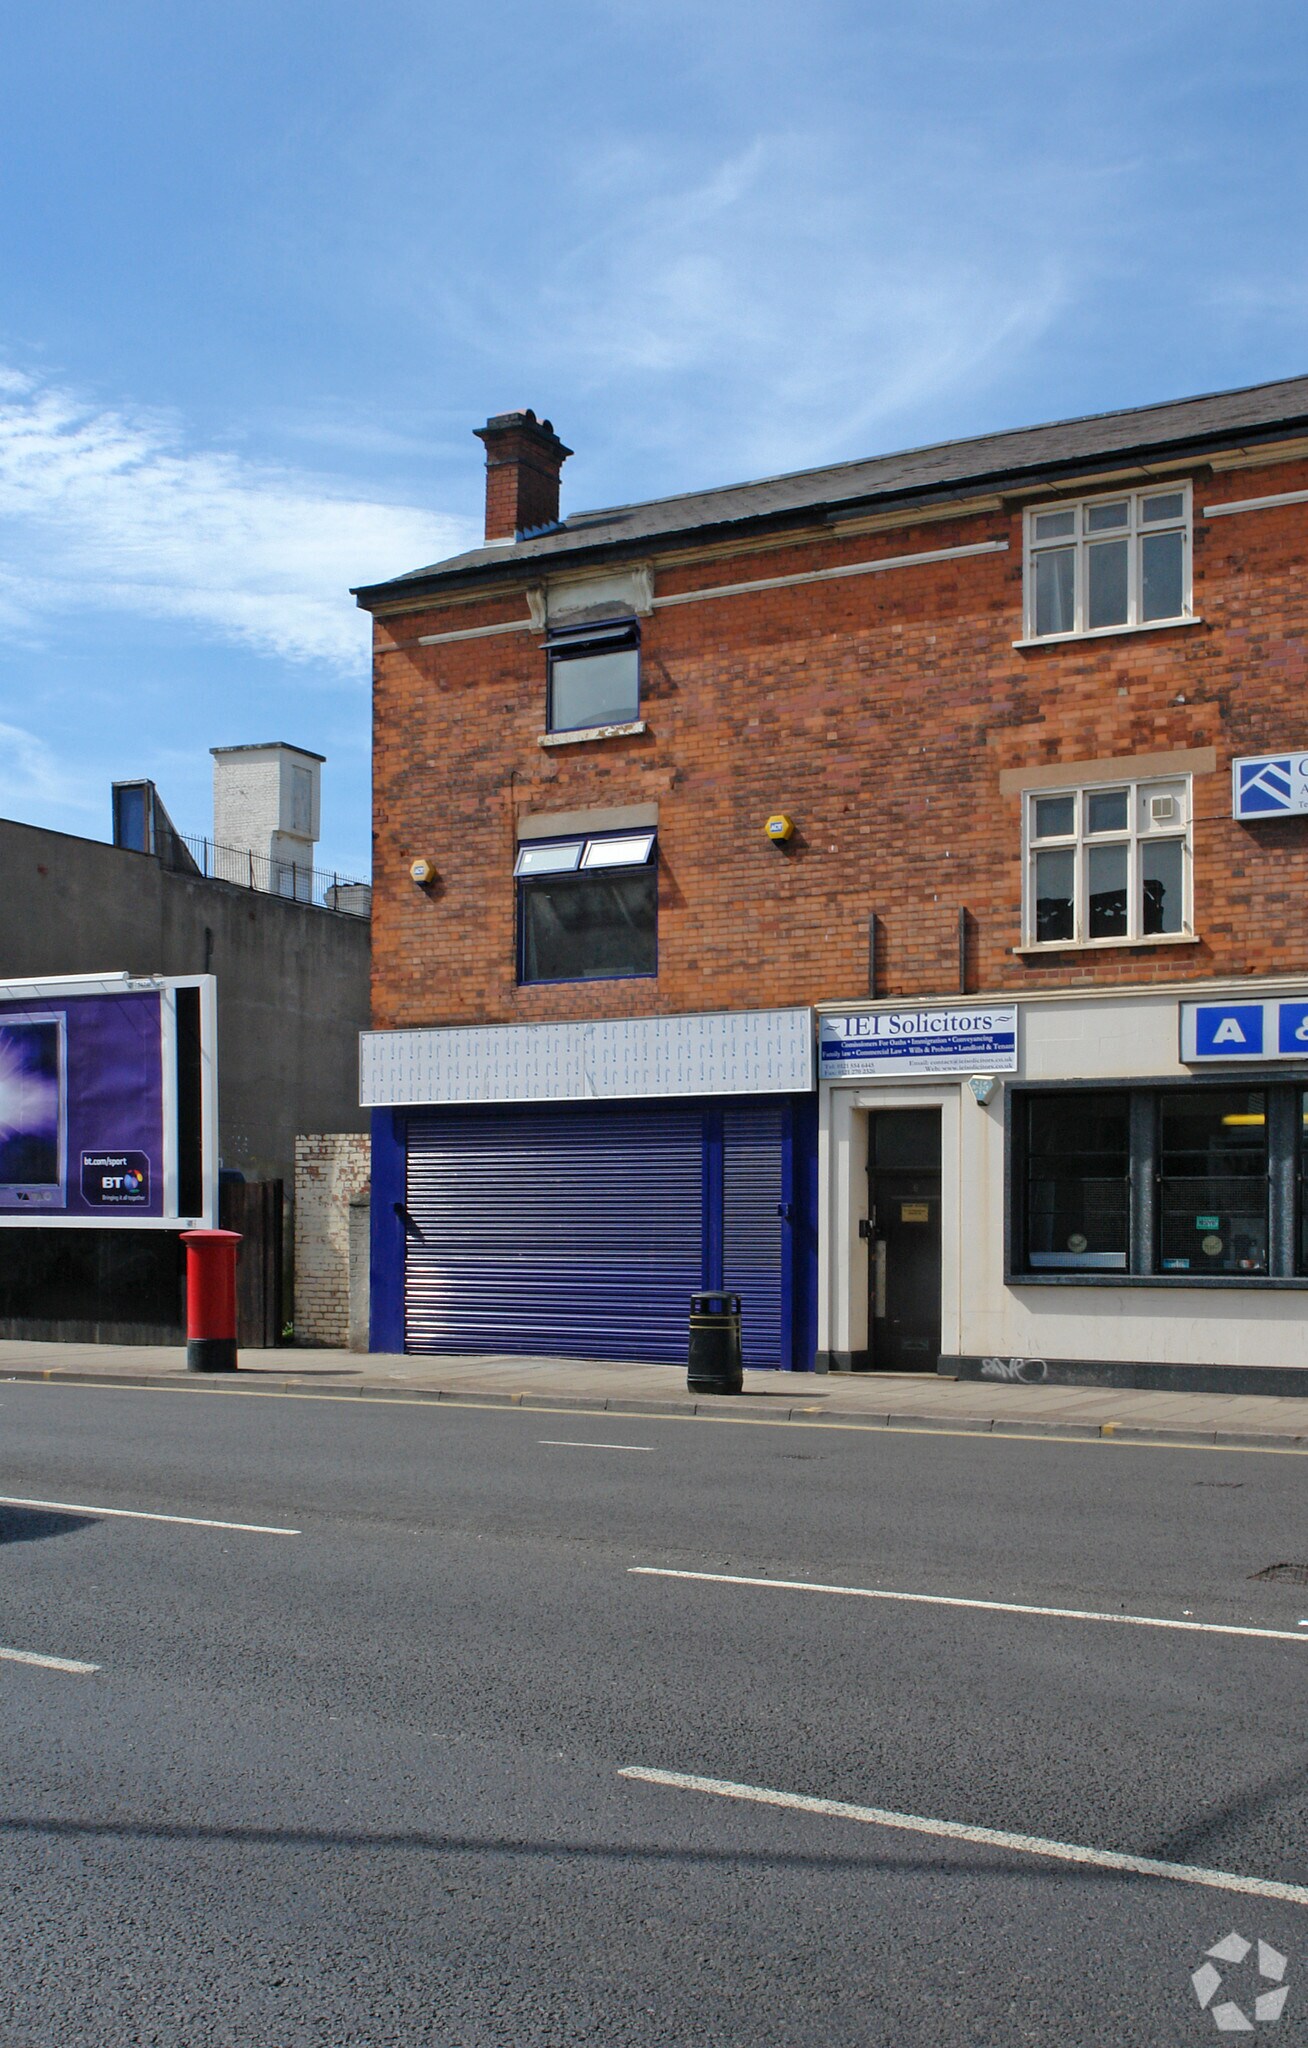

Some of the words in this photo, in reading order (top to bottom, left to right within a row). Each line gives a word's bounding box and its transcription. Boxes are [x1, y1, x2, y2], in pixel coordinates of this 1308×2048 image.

[844, 1016, 880, 1036] IEI
[889, 1012, 992, 1034] Solicitors
[1212, 1017, 1246, 1043] A
[911, 1037, 947, 1046] Immigration
[952, 1035, 993, 1044] Conveyancing
[822, 1050, 840, 1059] Family
[856, 1048, 889, 1056] Commercial
[931, 1045, 953, 1053] Probate
[84, 1156, 127, 1167] bt.com/sport
[102, 1176, 123, 1188] BT
